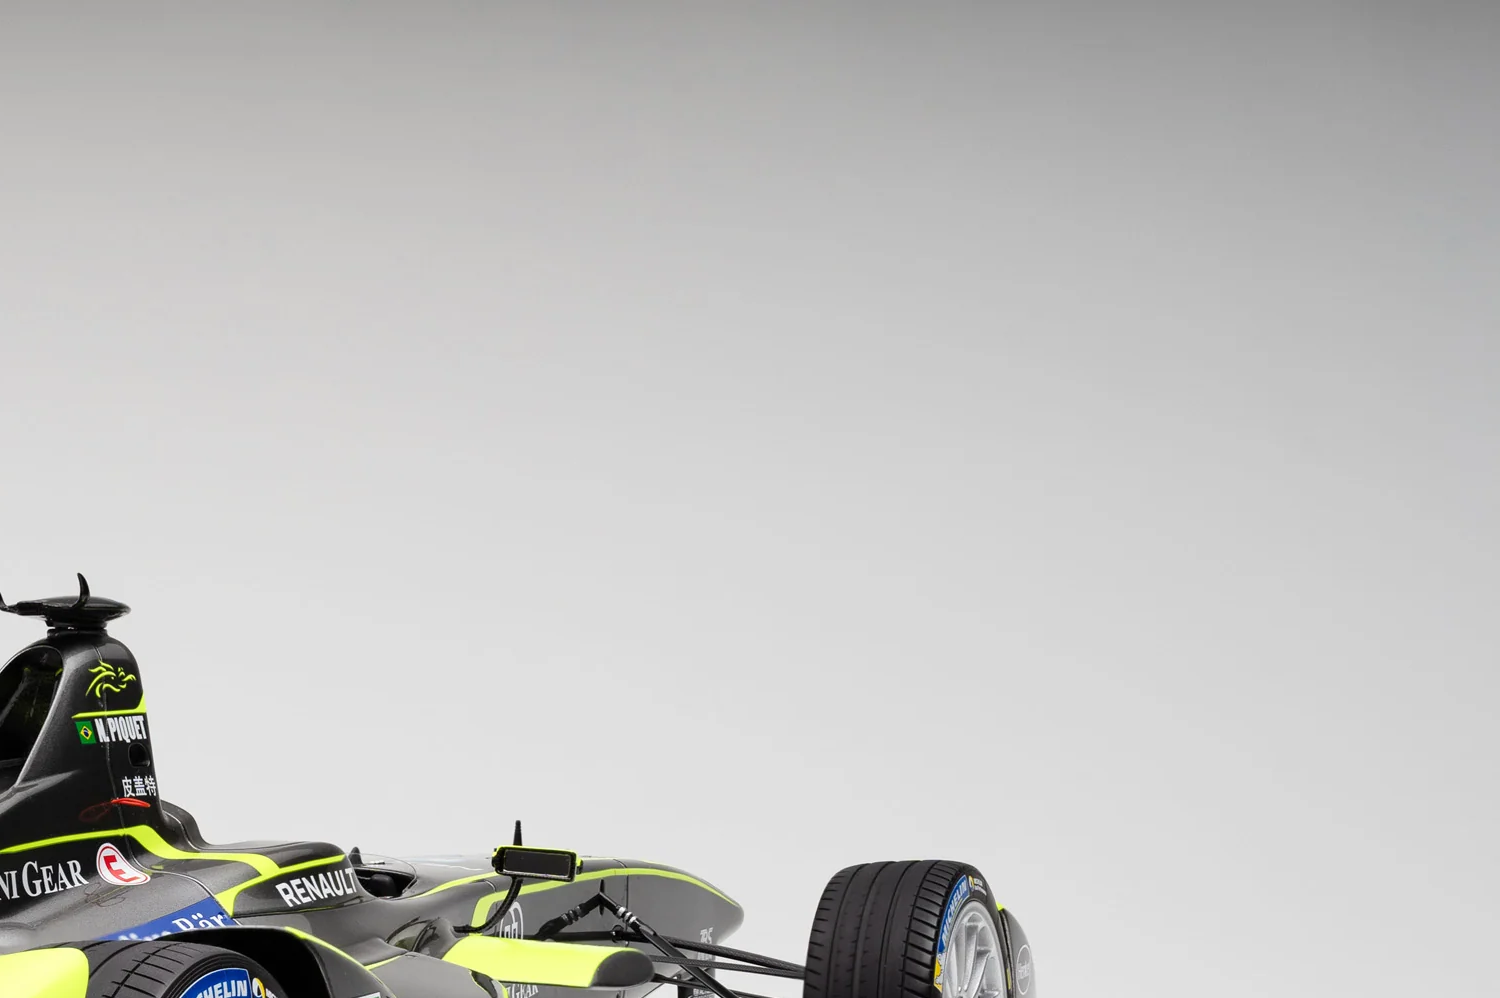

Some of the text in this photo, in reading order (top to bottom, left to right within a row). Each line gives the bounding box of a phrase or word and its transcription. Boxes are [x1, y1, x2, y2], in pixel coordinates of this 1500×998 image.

[122, 775, 157, 798] 皮盖特
[275, 868, 357, 908] RENAULT
